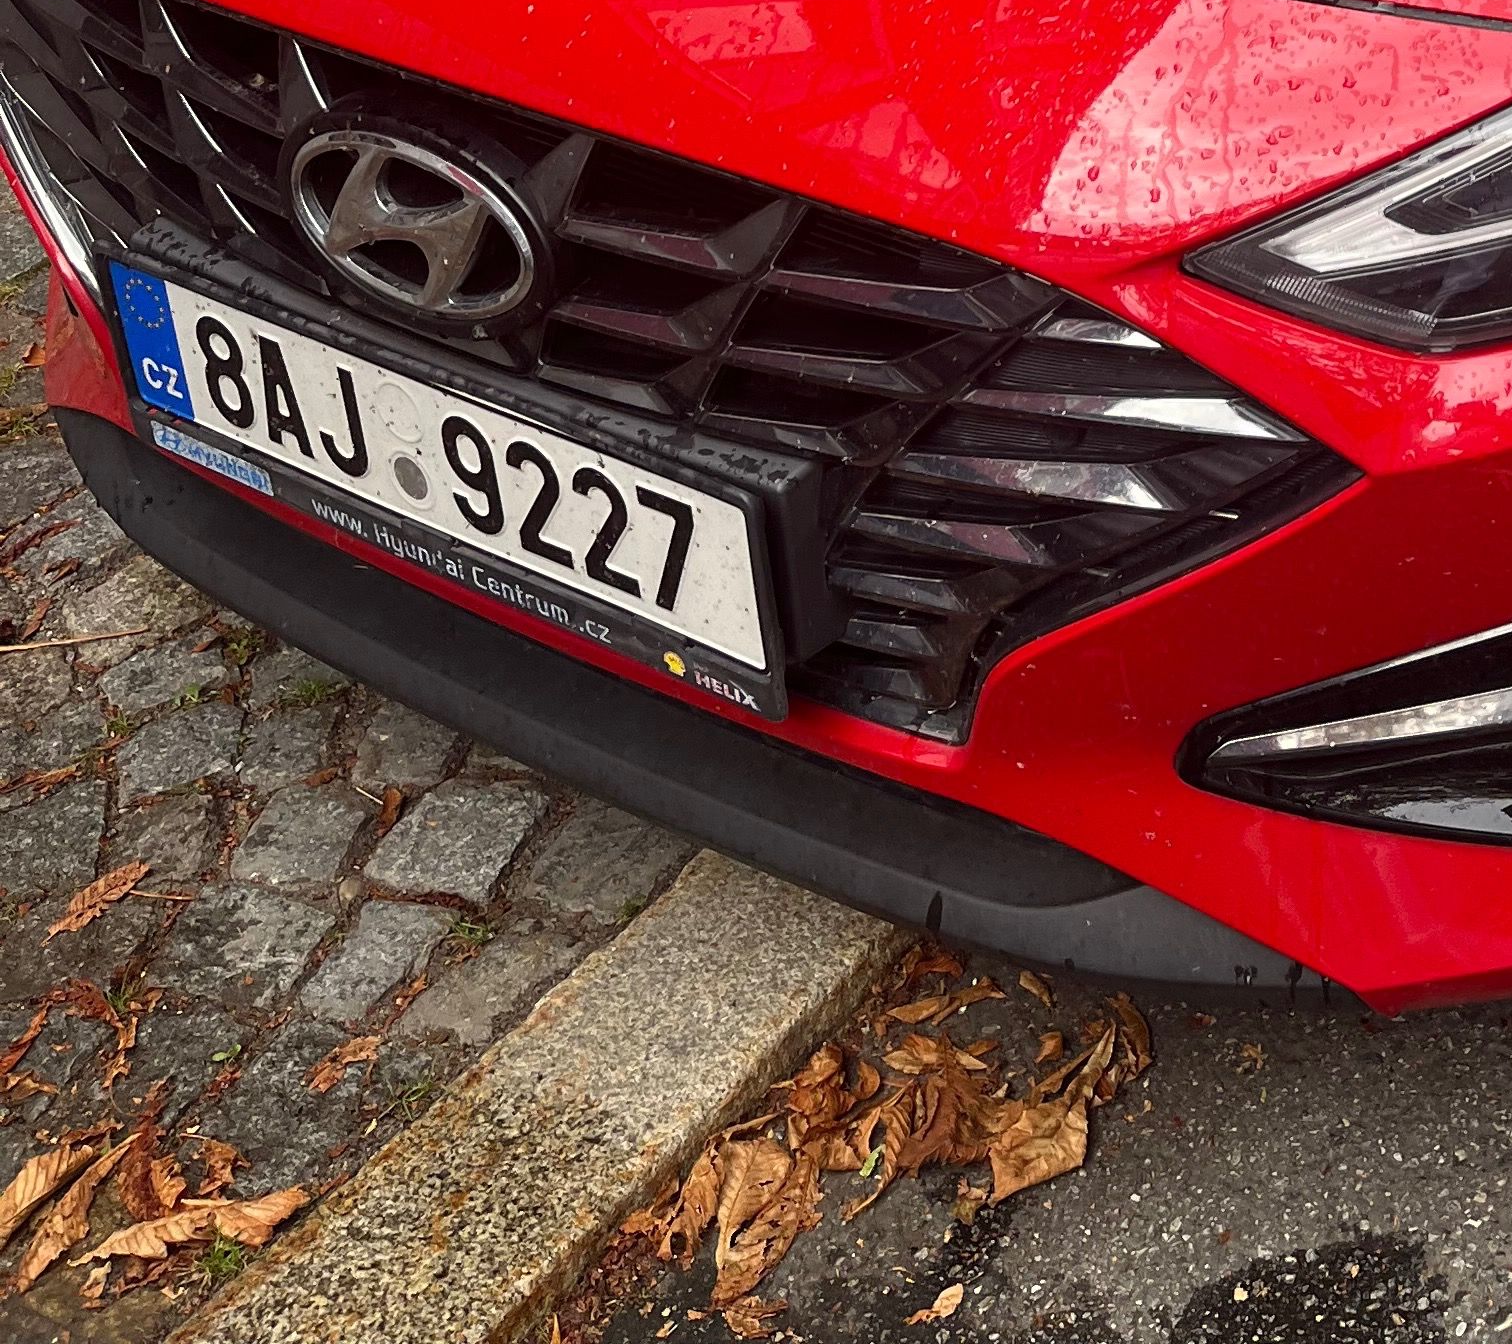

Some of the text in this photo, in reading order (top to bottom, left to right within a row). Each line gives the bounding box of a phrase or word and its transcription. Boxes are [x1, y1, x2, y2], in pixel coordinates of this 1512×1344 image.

[142, 357, 183, 400] CZ
[195, 315, 695, 611] 8AJ 9227
[693, 669, 762, 713] HELIX
